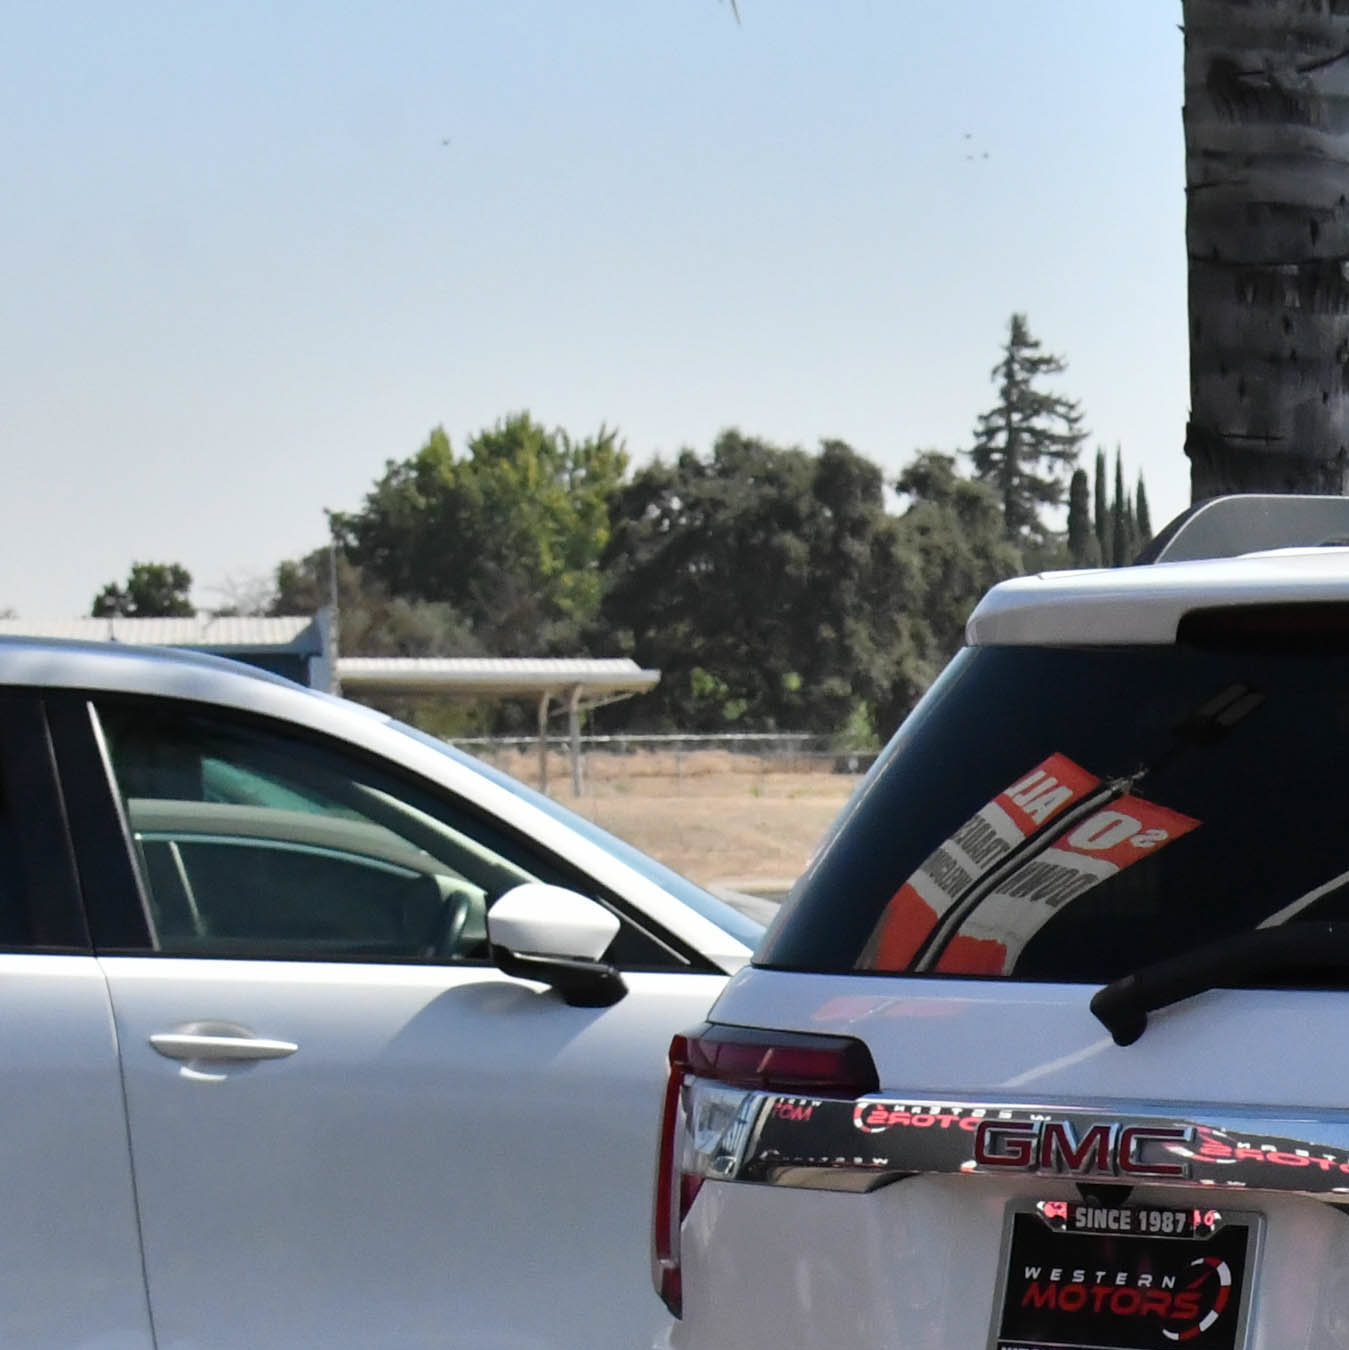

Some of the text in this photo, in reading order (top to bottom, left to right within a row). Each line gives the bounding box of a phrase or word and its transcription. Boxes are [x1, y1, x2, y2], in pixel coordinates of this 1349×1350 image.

[974, 1119, 1198, 1179] GMC
[1076, 1207, 1187, 1234] SINCE 1987
[1024, 1266, 1176, 1290] WESTERN
[1021, 1281, 1203, 1320] MOTORS
